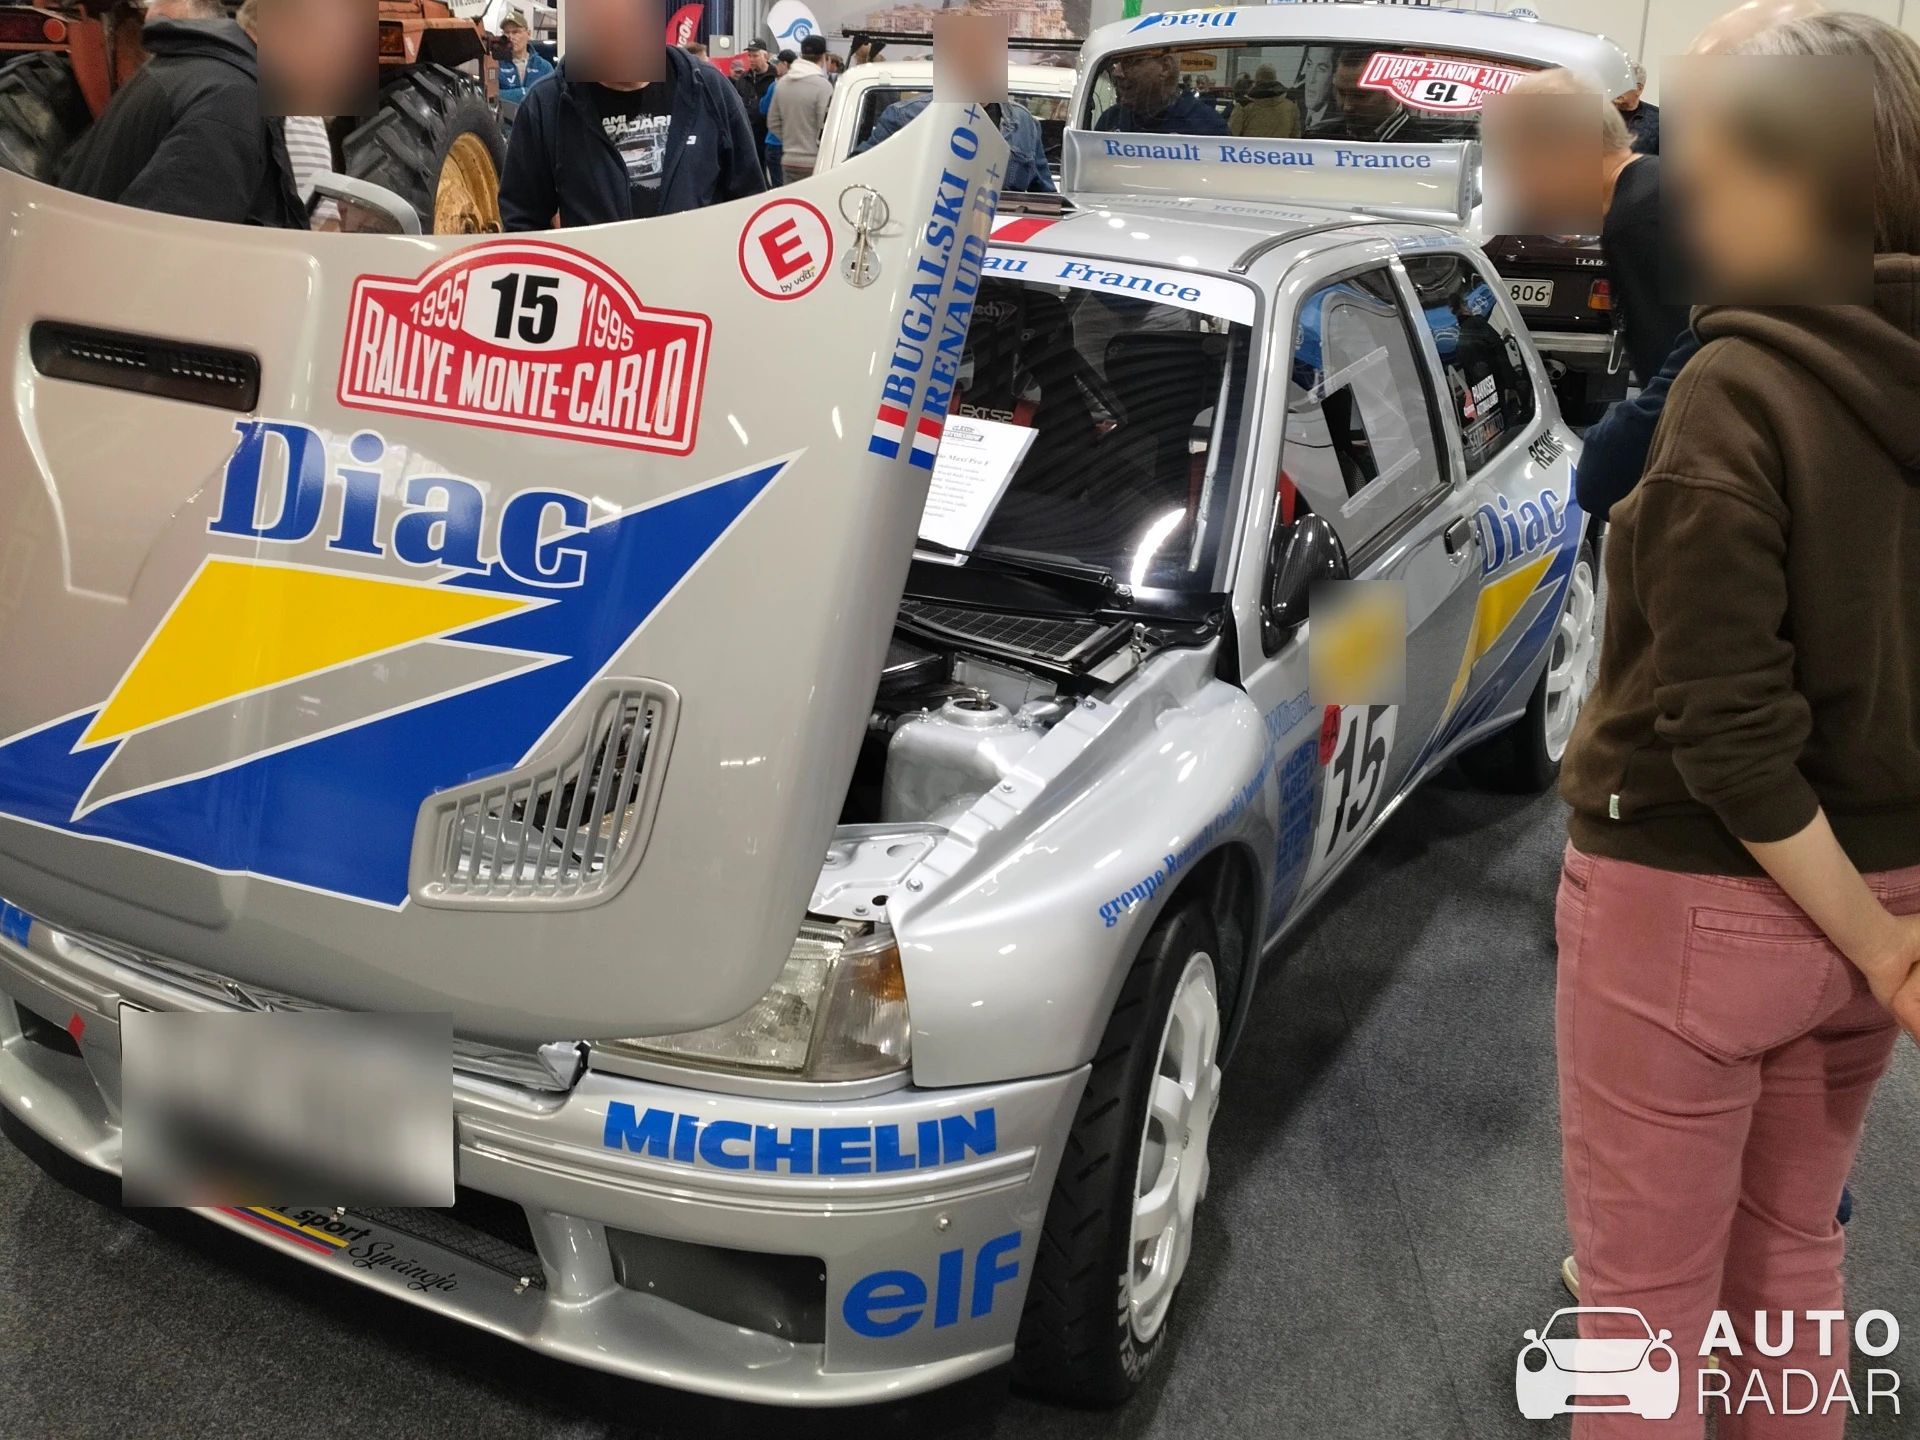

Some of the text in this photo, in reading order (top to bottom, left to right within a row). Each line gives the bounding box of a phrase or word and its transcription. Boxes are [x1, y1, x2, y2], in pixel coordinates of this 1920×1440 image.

[1161, 11, 1238, 28] Diac
[1370, 56, 1480, 84] MONTE-CARLO
[1424, 81, 1458, 103] 15
[602, 115, 627, 126] AMI
[604, 114, 672, 135] PAJARI
[1104, 139, 1432, 168] Renault Réseau France
[758, 216, 814, 281] E
[1580, 258, 1607, 267] LAD
[409, 268, 468, 331] 1995
[491, 272, 561, 345] 15
[779, 282, 793, 293] by
[881, 167, 969, 409] BUGALSKI
[1055, 261, 1202, 303] France
[1510, 284, 1547, 302] 806
[584, 282, 635, 352] 1995
[921, 234, 987, 419] RENAUD
[353, 296, 688, 437] RALLYE MONTE-CARLO
[206, 416, 592, 589] Diac
[1472, 488, 1566, 578] Diac
[1325, 704, 1387, 860] 15
[1098, 868, 1165, 928] groupe
[603, 1101, 997, 1175] MICHELIN
[293, 1208, 372, 1242] sport
[842, 1230, 1022, 1339] elf
